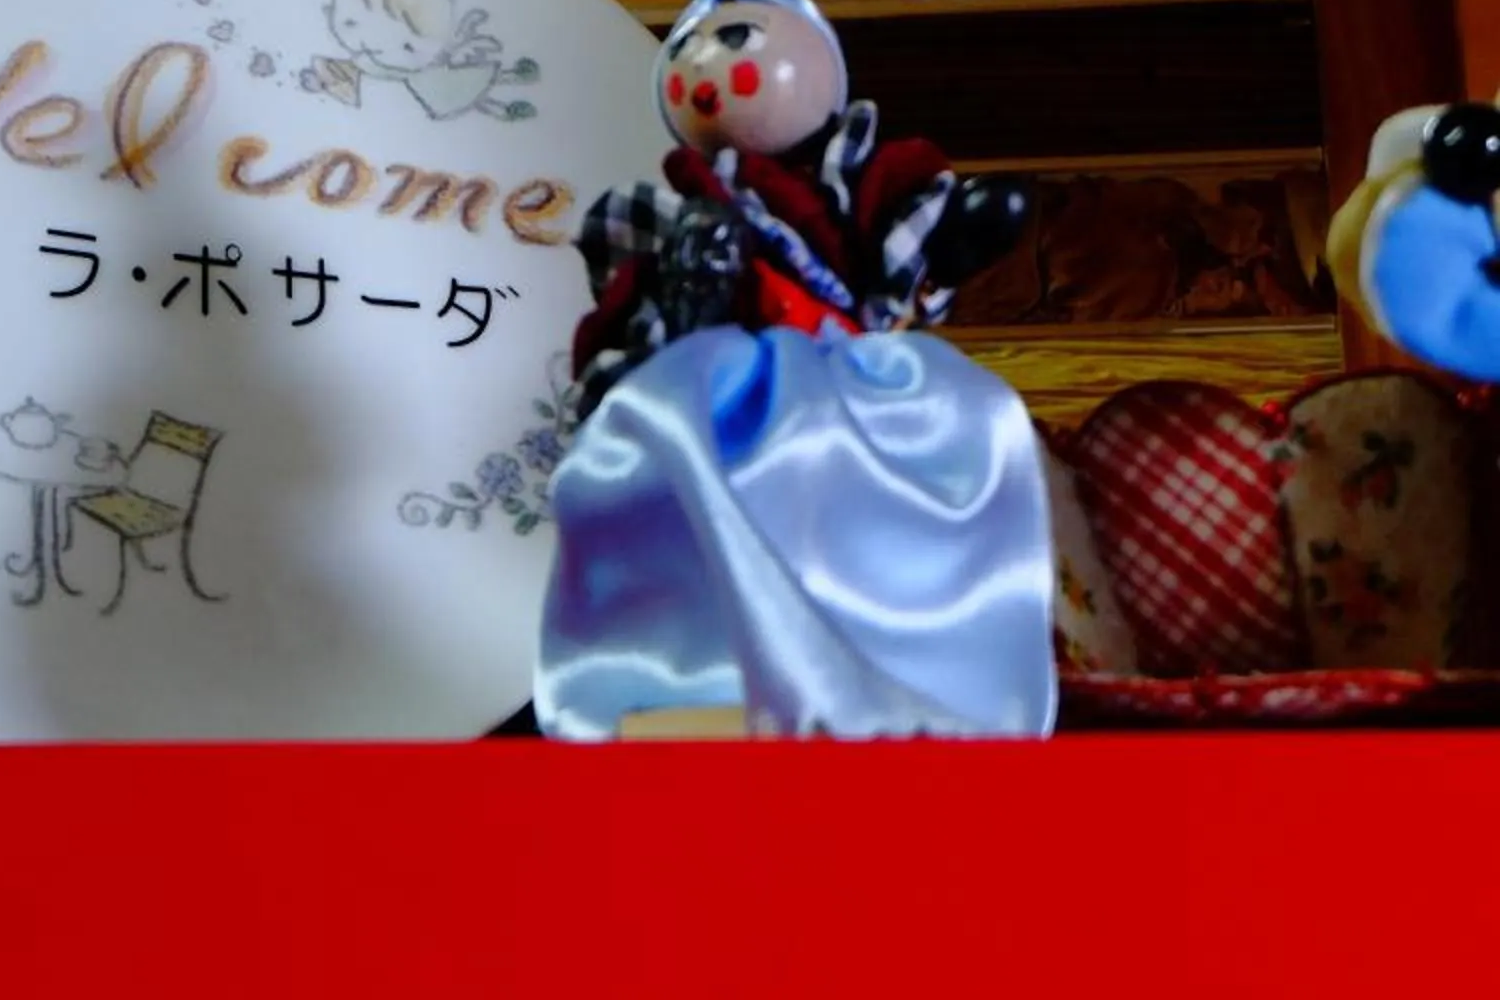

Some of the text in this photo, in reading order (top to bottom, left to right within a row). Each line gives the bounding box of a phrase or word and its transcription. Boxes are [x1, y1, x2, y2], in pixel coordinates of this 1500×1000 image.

[40, 228, 521, 348] ラ・ポサーダ
